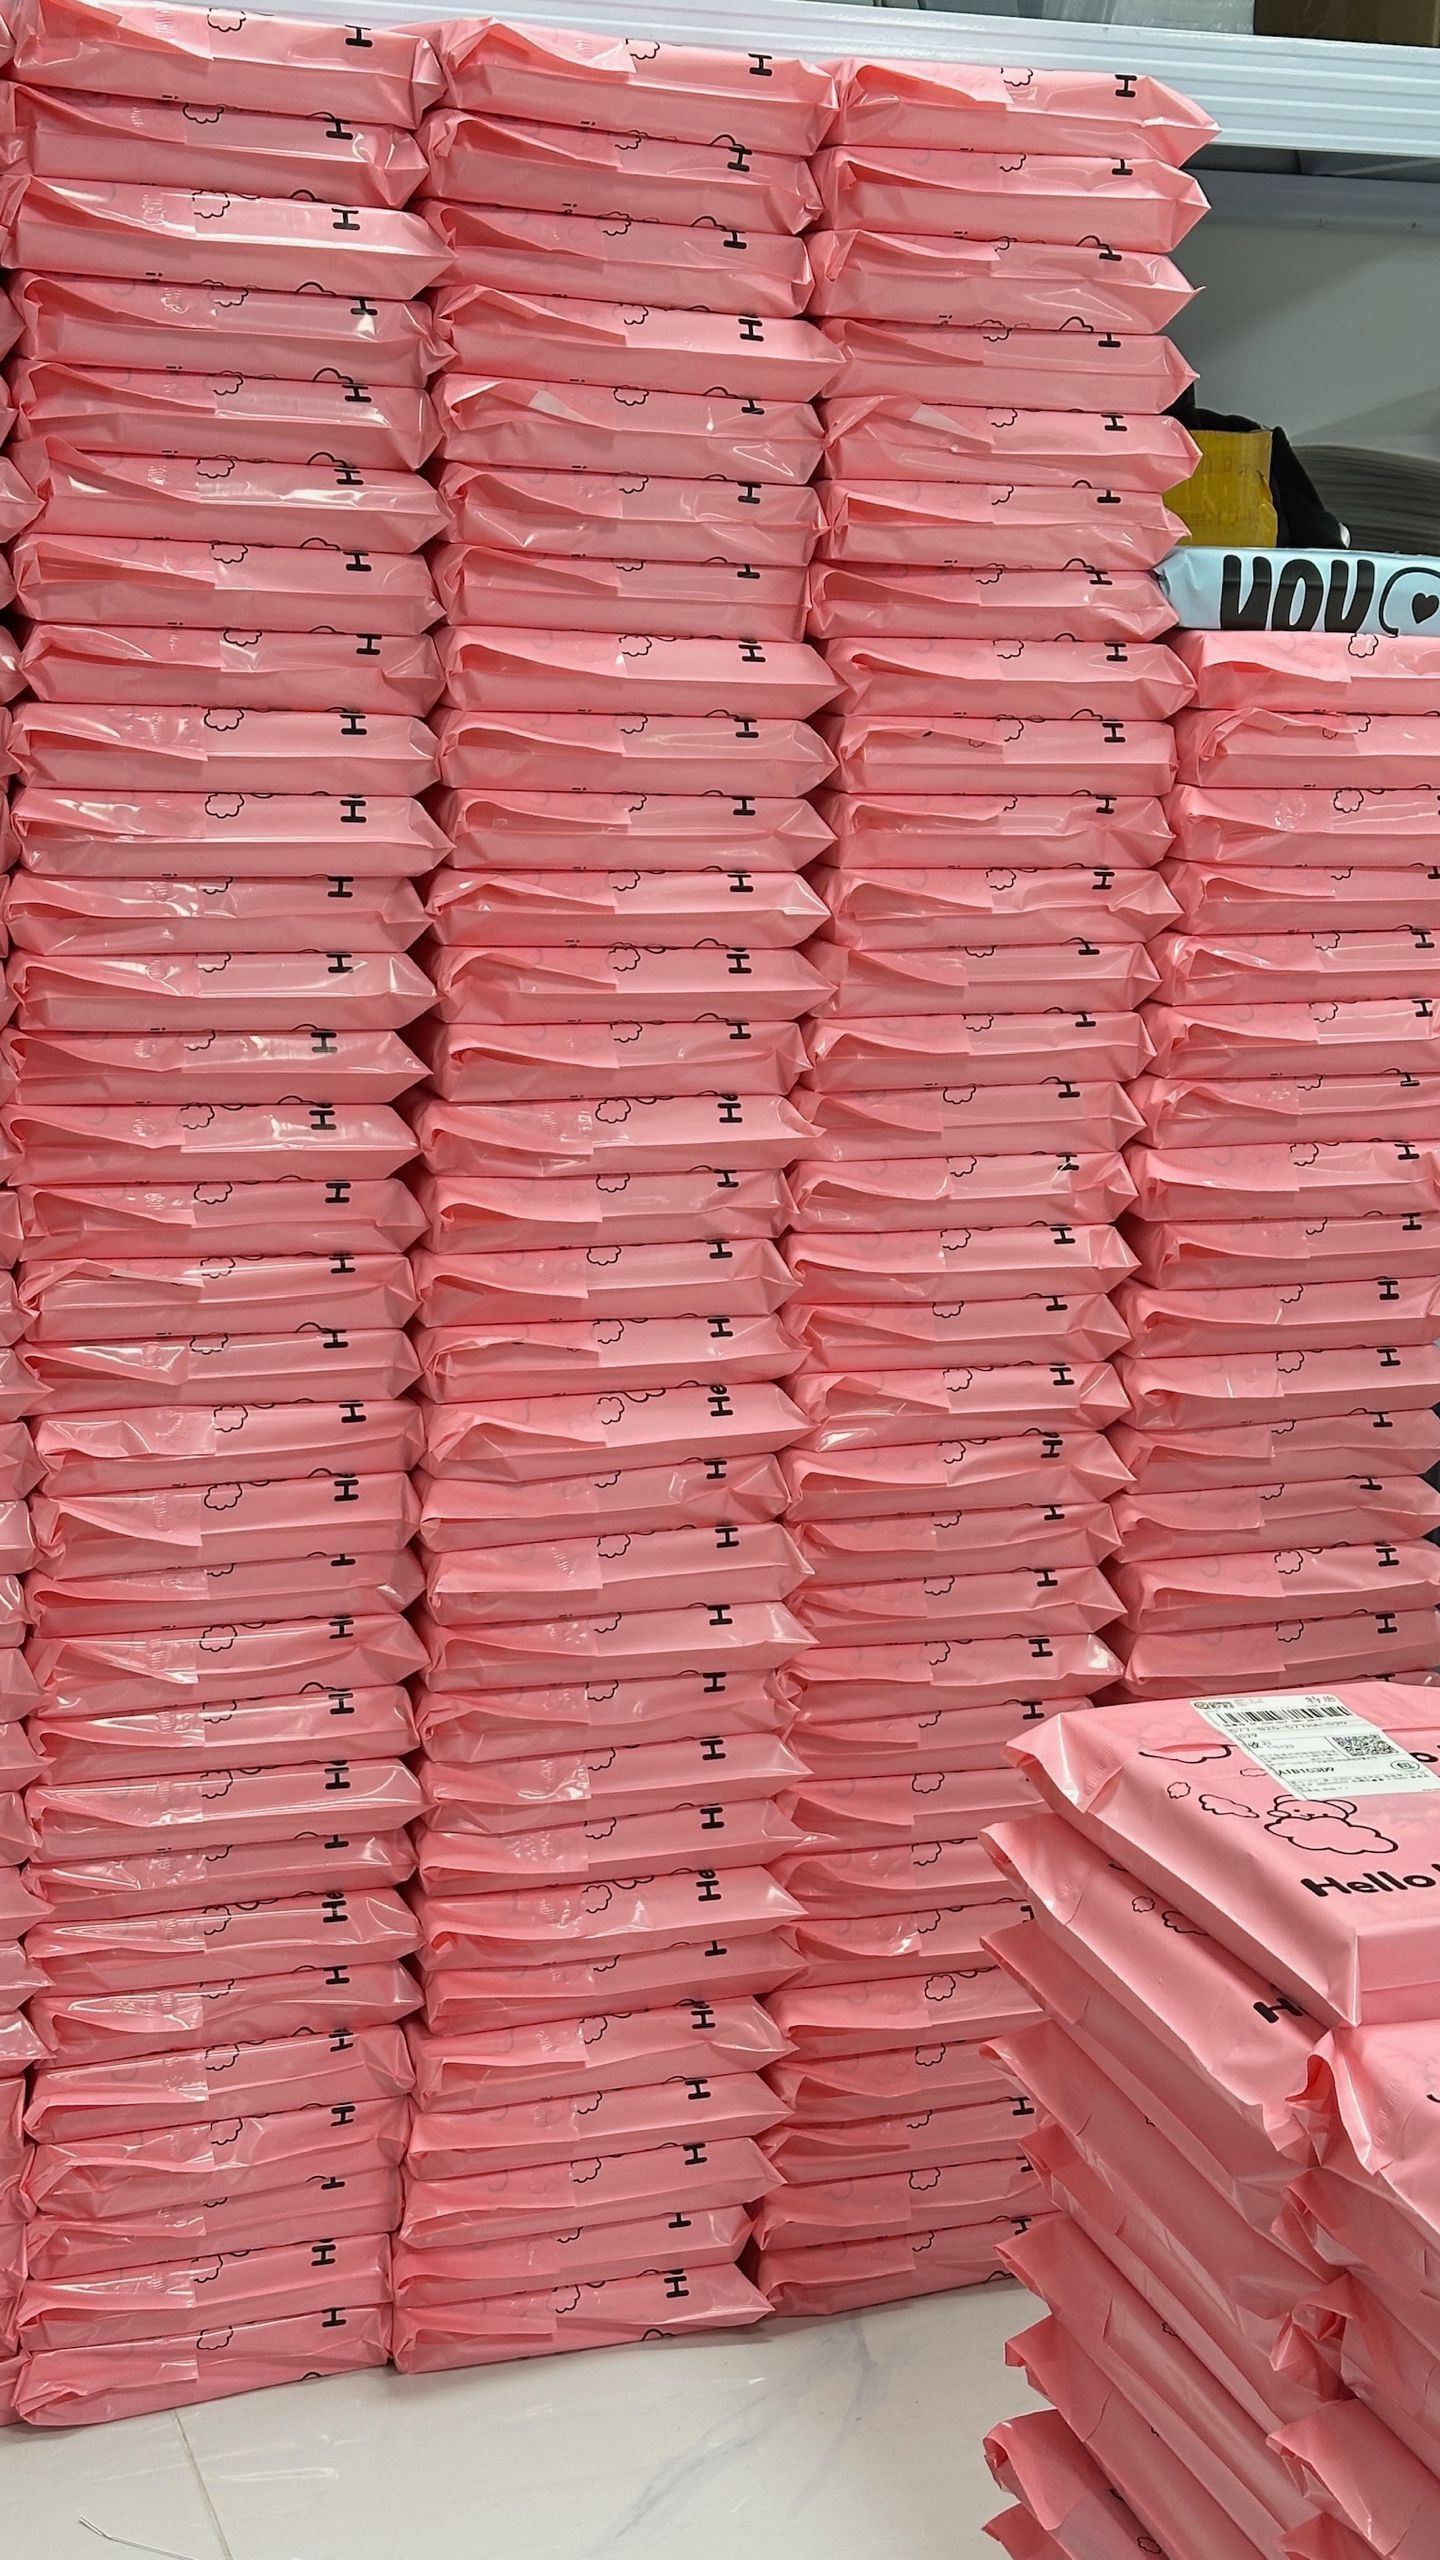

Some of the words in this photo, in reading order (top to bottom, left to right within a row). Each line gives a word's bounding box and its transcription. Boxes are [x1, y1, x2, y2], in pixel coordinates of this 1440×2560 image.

[345, 25, 372, 47] H
[748, 53, 772, 77] H
[1115, 75, 1137, 97] H
[325, 119, 353, 140] H
[727, 146, 752, 172] H
[331, 208, 360, 230] H
[723, 231, 747, 249] H
[347, 297, 377, 315] H
[342, 384, 371, 402] H
[1101, 414, 1127, 432] H
[334, 467, 363, 485] H
[737, 481, 762, 504] H
[343, 551, 371, 571] H
[356, 634, 382, 655] H
[738, 643, 766, 663] H
[1104, 642, 1128, 661] H
[733, 718, 759, 738] H
[1102, 722, 1125, 743] H
[732, 796, 756, 816] H
[1095, 795, 1117, 814] H
[327, 876, 353, 897] H
[727, 874, 754, 892] H
[1092, 872, 1115, 889] H
[1411, 931, 1434, 948] H
[326, 953, 353, 973] H
[1412, 1000, 1433, 1016] H
[726, 1023, 752, 1040] H
[311, 1031, 337, 1052] H
[1400, 1072, 1419, 1086] H
[1056, 1081, 1080, 1098] H
[1394, 1142, 1419, 1159] H
[1056, 1154, 1079, 1171] H
[713, 1169, 739, 1187] H
[325, 1183, 351, 1203] H
[1401, 1212, 1422, 1230] H
[1050, 1226, 1075, 1244] H
[706, 1240, 733, 1259] H
[329, 1255, 355, 1274] H
[1378, 1281, 1399, 1300] H
[1045, 1296, 1068, 1311] H
[707, 1318, 733, 1338] H
[323, 1329, 349, 1348] H
[1377, 1348, 1401, 1366] H
[1050, 1367, 1074, 1385] H
[339, 1403, 366, 1423] H
[1373, 1411, 1393, 1426] H
[1040, 1439, 1063, 1458] H
[703, 1460, 727, 1479] H
[1360, 1477, 1382, 1490] H
[1043, 1504, 1065, 1520] H
[715, 1527, 739, 1548] H
[1034, 1569, 1058, 1586] H
[707, 1605, 733, 1625] H
[1376, 1613, 1397, 1633] H
[1029, 1639, 1053, 1657] H
[703, 1672, 726, 1692] H
[328, 1692, 354, 1714] H
[1020, 1701, 1044, 1719] H
[700, 1739, 726, 1760] H
[699, 1806, 725, 1829] H
[1300, 1871, 1436, 1897] Hello
[323, 1965, 350, 1984] H
[328, 2031, 353, 2052] H
[684, 2078, 711, 2099] H
[1010, 2096, 1035, 2116] H
[330, 2105, 355, 2127] H
[683, 2143, 707, 2165] H
[1010, 2217, 1032, 2235] H
[321, 2307, 346, 2327] H
